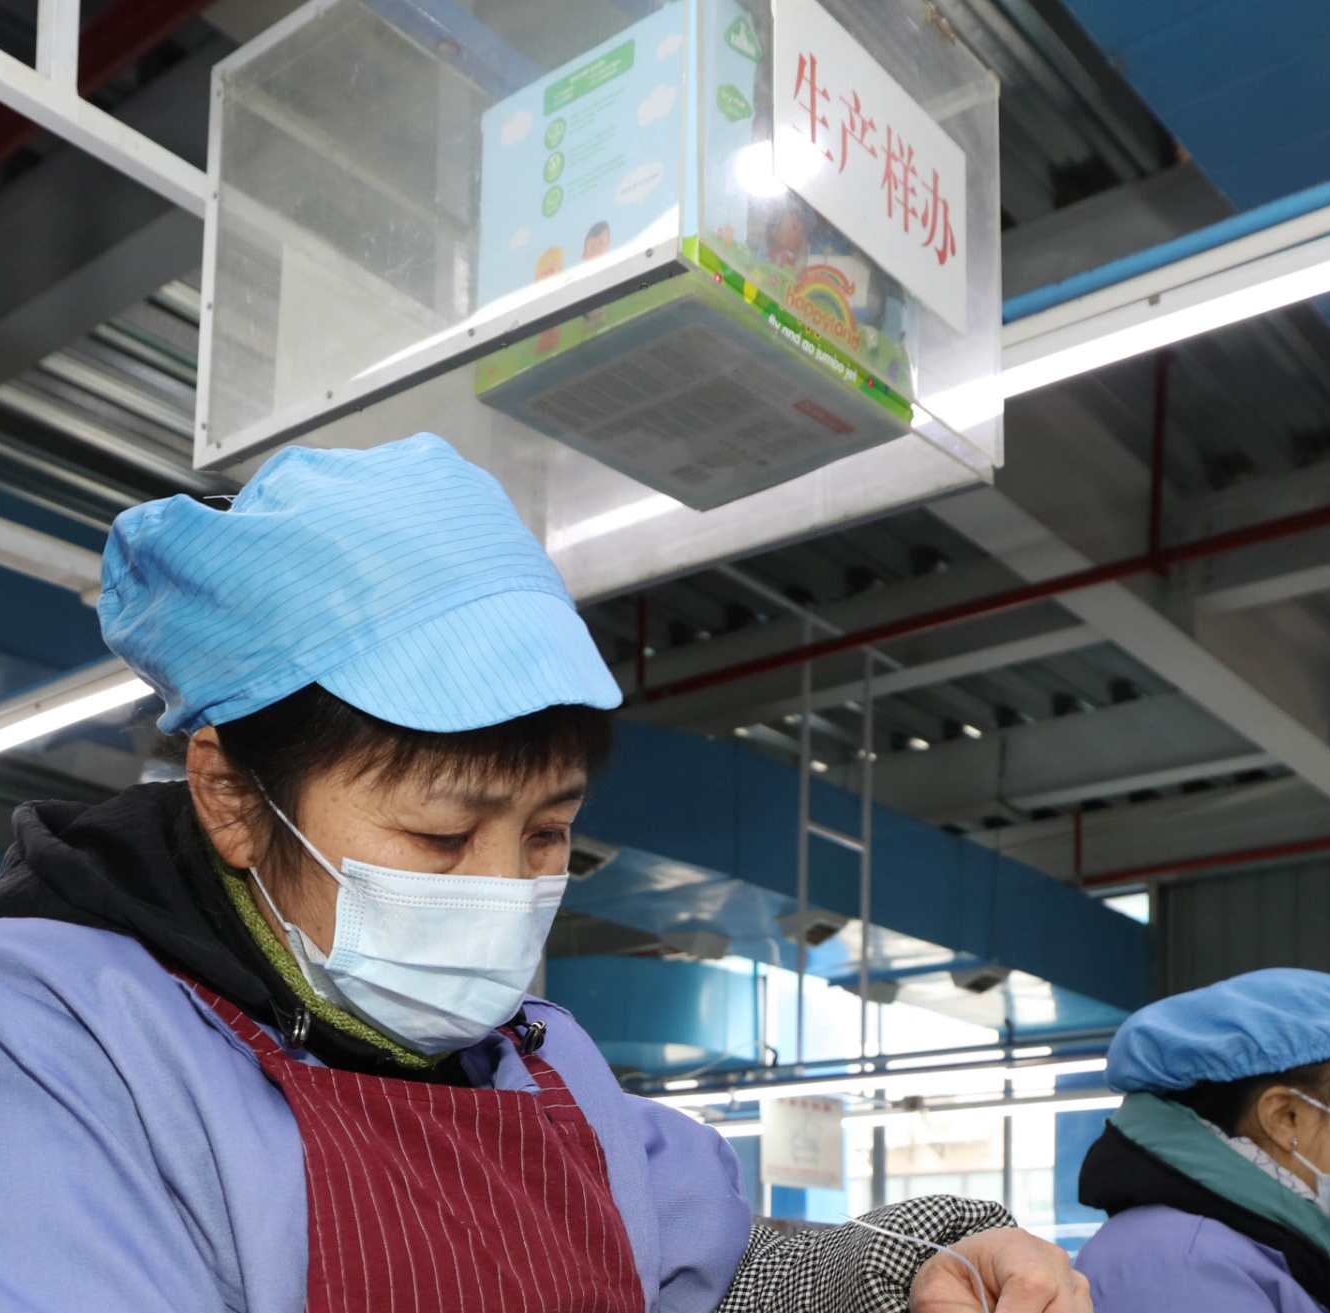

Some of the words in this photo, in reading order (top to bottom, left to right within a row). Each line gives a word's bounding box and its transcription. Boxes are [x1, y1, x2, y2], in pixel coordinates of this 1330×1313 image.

[792, 51, 956, 266] 生产样办
[785, 283, 862, 352] happyland
[781, 326, 802, 345] and
[816, 343, 845, 373] jumbo
[844, 363, 858, 383] jet
